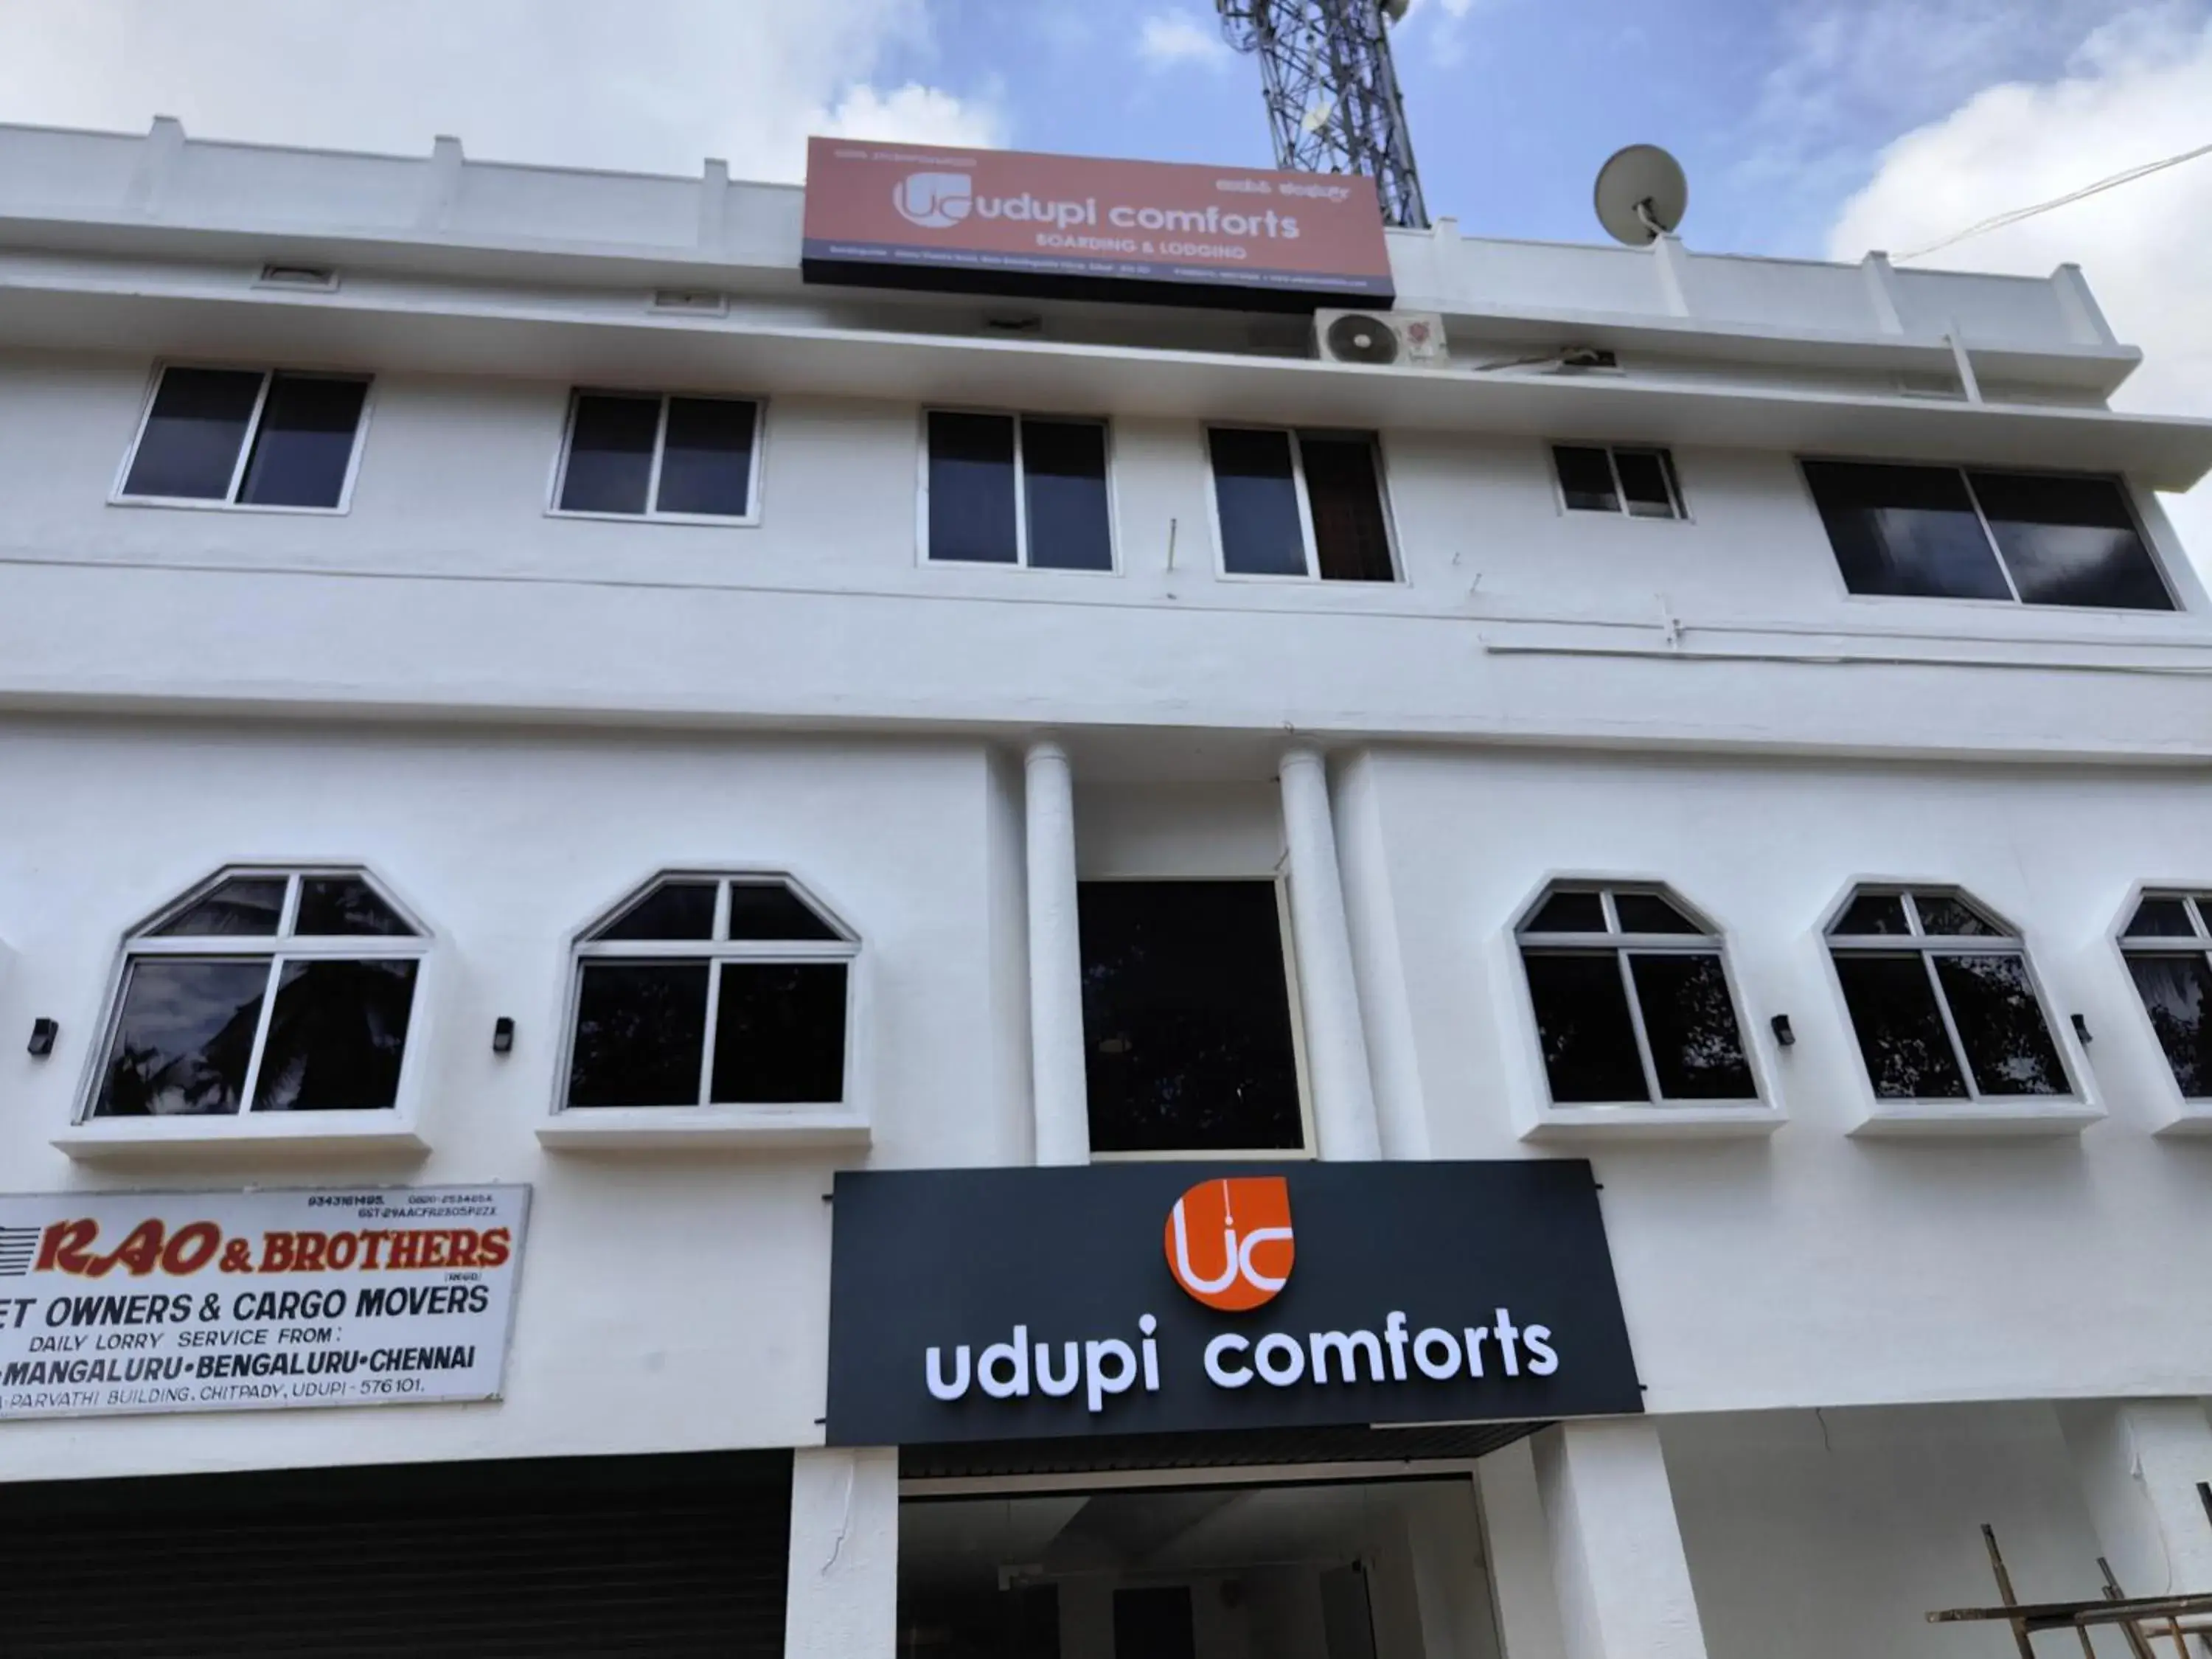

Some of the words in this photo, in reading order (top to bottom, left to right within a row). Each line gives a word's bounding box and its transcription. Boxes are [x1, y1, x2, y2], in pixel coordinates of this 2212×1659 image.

[975, 192, 1097, 229] udupi
[1108, 206, 1301, 239] comforts
[35, 1218, 220, 1278] RAO
[220, 1238, 253, 1273] &
[257, 1227, 511, 1274] BROTHERS
[46, 1293, 192, 1327] OWNERS
[198, 1292, 221, 1323] &
[233, 1289, 347, 1321] CARGO
[355, 1285, 490, 1318] MOVERS
[29, 1335, 88, 1353] DAILY
[96, 1333, 164, 1350] LORRY
[178, 1329, 268, 1348] SERVICE
[926, 1315, 1159, 1411] udupi
[1205, 1308, 1558, 1388] comforts
